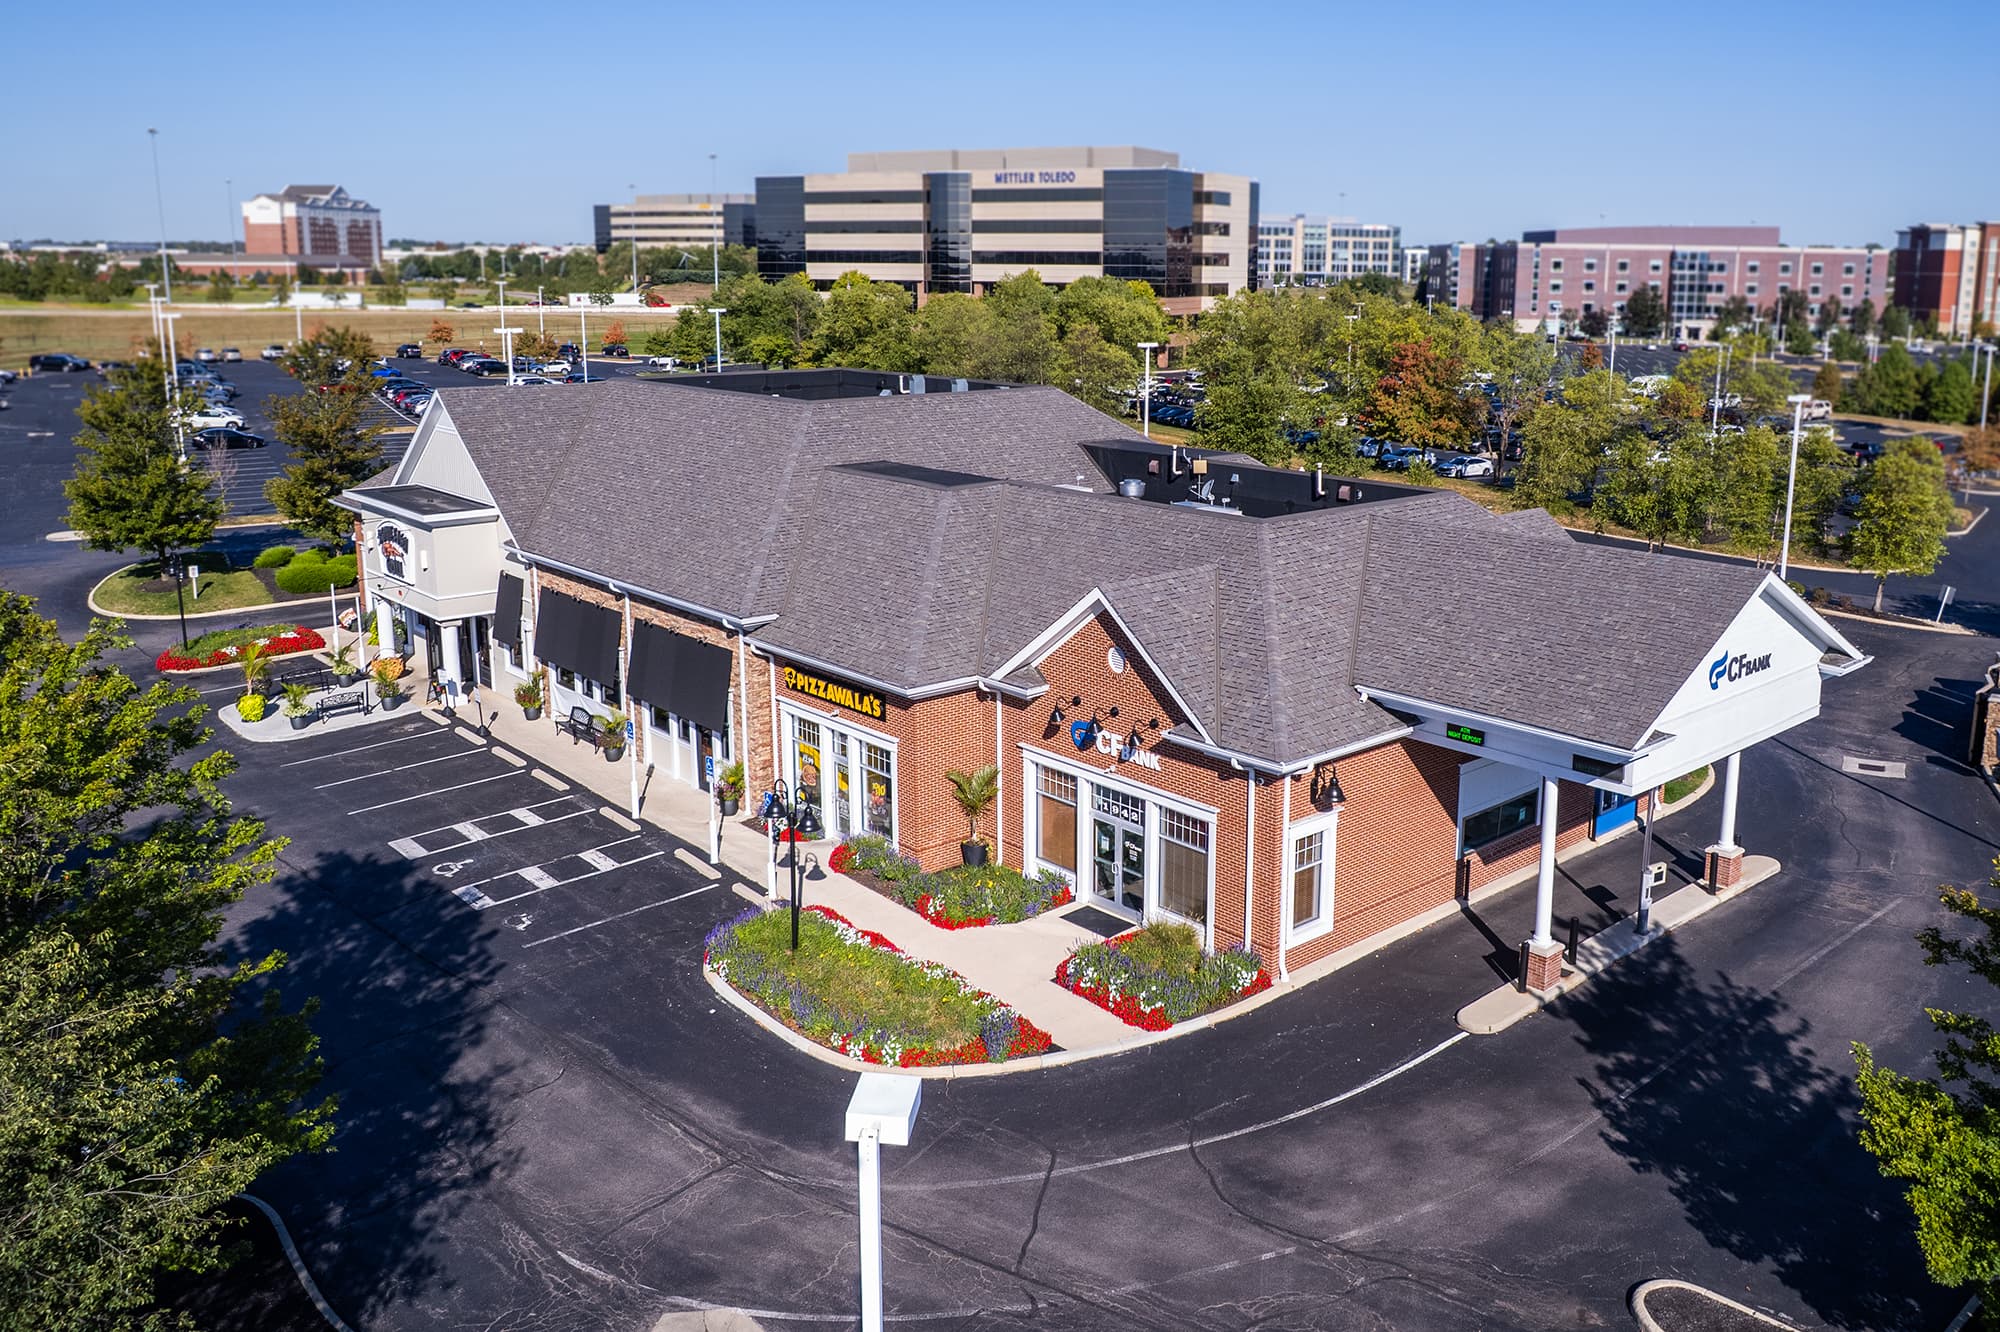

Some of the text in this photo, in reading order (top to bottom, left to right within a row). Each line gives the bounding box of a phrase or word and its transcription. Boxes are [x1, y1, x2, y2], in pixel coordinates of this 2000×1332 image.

[994, 170, 1076, 184] METTLER TOLEDO
[796, 673, 881, 718] PIZZAWALA'S
